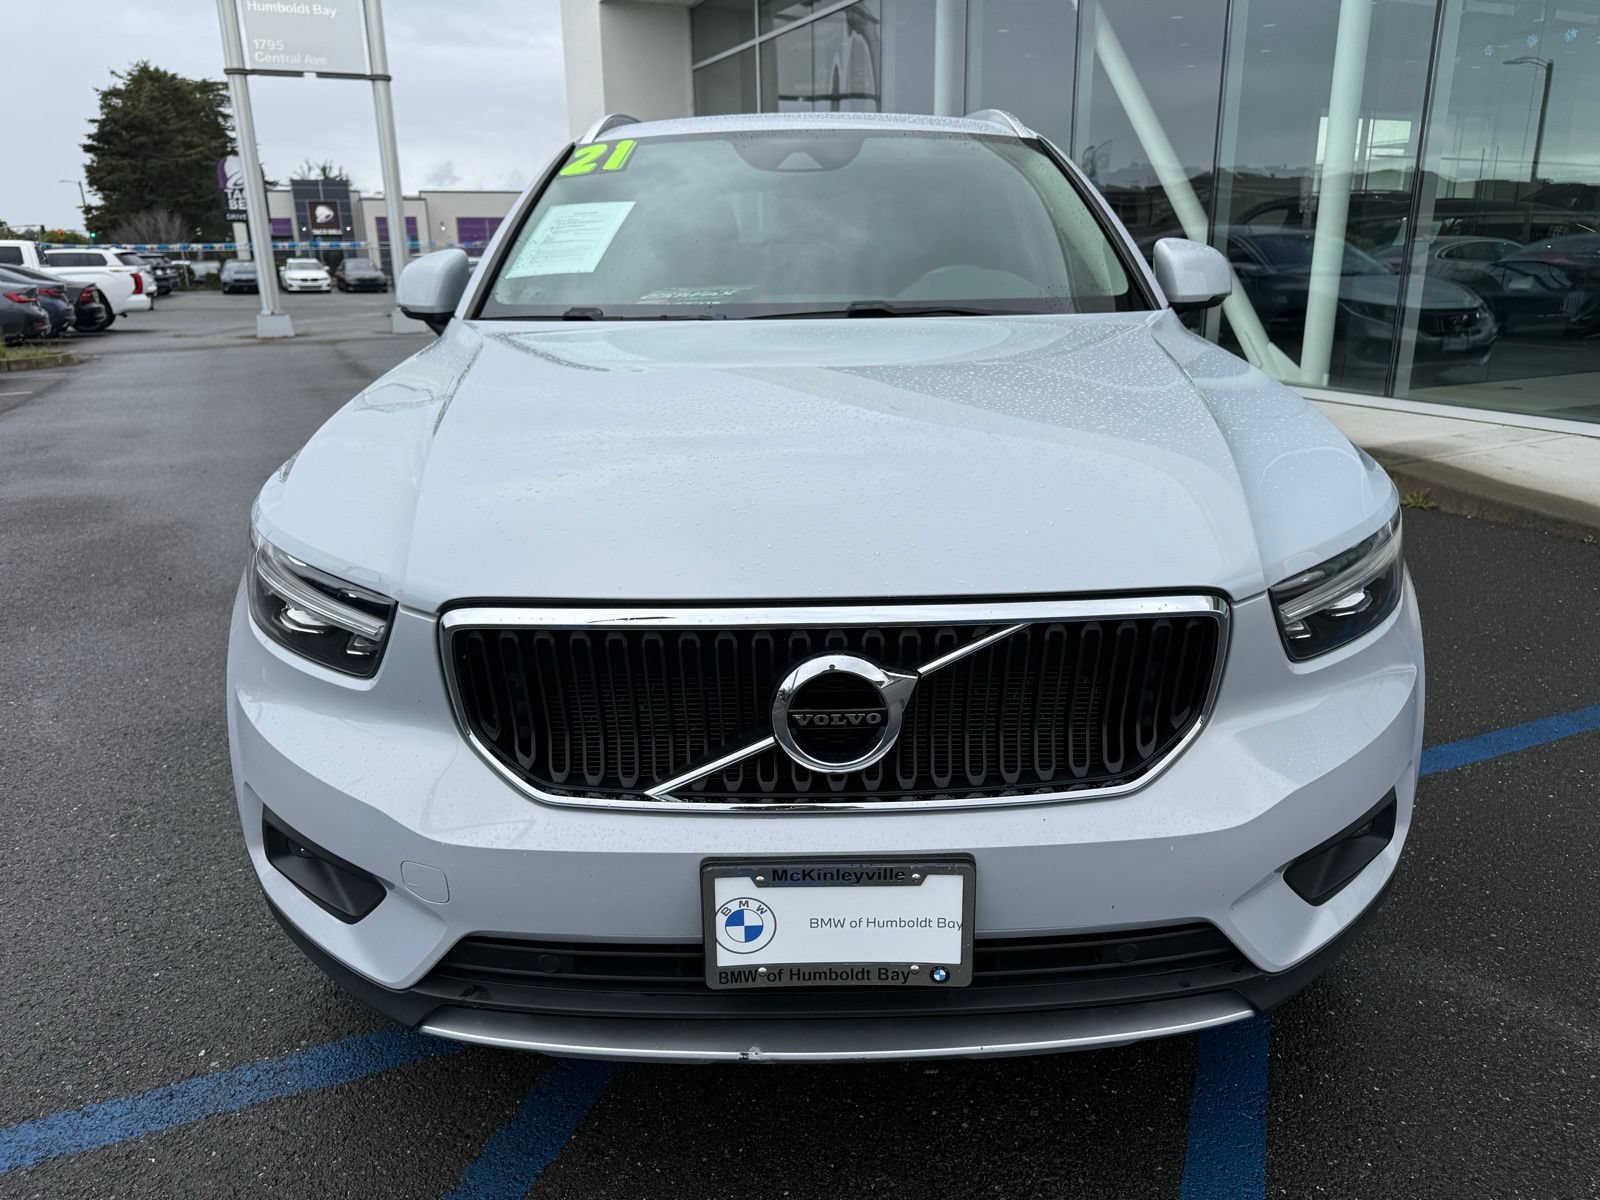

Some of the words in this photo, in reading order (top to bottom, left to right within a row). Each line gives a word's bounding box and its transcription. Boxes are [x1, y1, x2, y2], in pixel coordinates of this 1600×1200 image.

[247, 0, 309, 15] Humboldt
[313, 5, 337, 19] Bay
[253, 39, 284, 51] 1795
[254, 51, 301, 64] Central
[304, 53, 328, 65] Ave
[559, 139, 637, 176] 21
[228, 199, 247, 210] BE
[792, 713, 882, 726] VOLVO
[772, 868, 906, 885] McKinleyville
[720, 899, 768, 917] BMW
[809, 917, 846, 929] BMW
[849, 917, 864, 929] of
[866, 916, 933, 929] Humboldt
[937, 917, 963, 931] Bay
[718, 969, 758, 985] BMW
[766, 968, 784, 983] of
[789, 967, 874, 983] Humboldt
[877, 967, 911, 985] Bay
